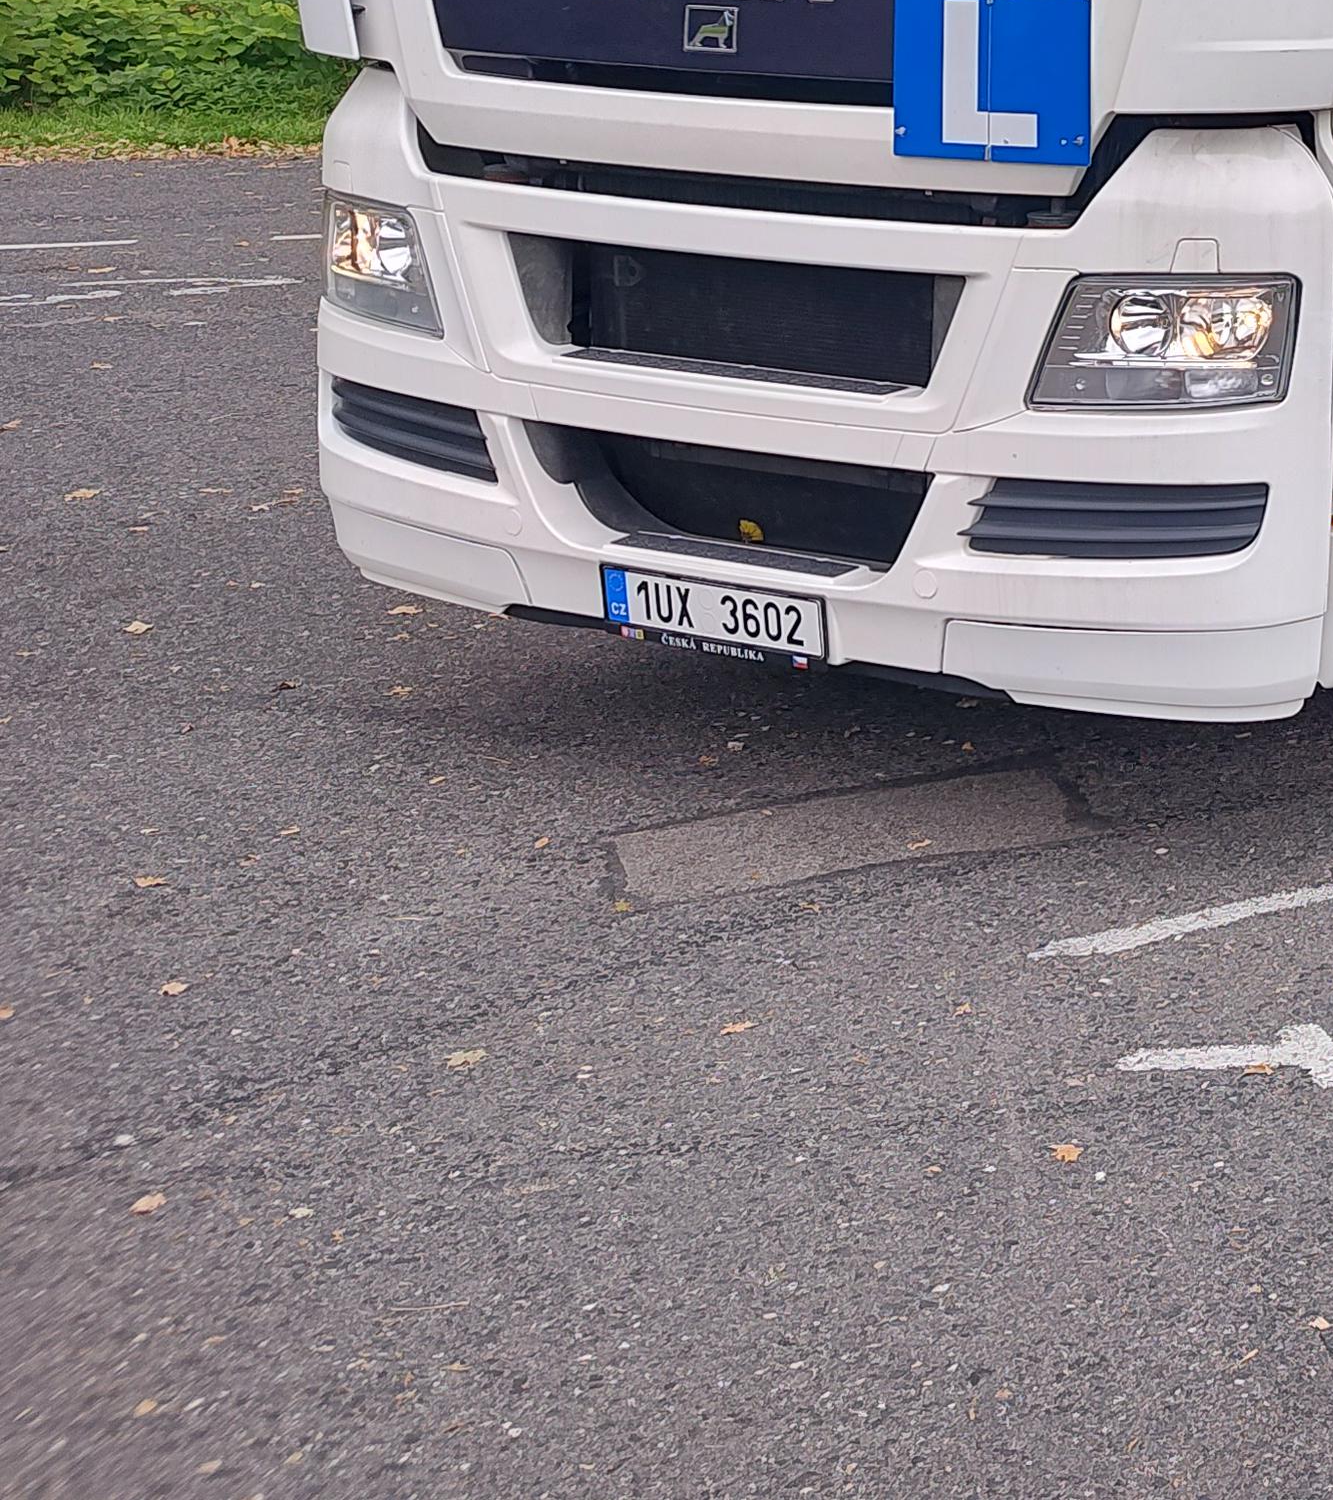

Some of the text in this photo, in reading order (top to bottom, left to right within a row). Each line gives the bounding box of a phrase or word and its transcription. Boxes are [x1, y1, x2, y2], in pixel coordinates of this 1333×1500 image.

[611, 601, 628, 617] CZ
[636, 580, 805, 648] 1UX 3602
[661, 632, 697, 651] ČESKÁ
[701, 641, 765, 662] REPUBLIKA
